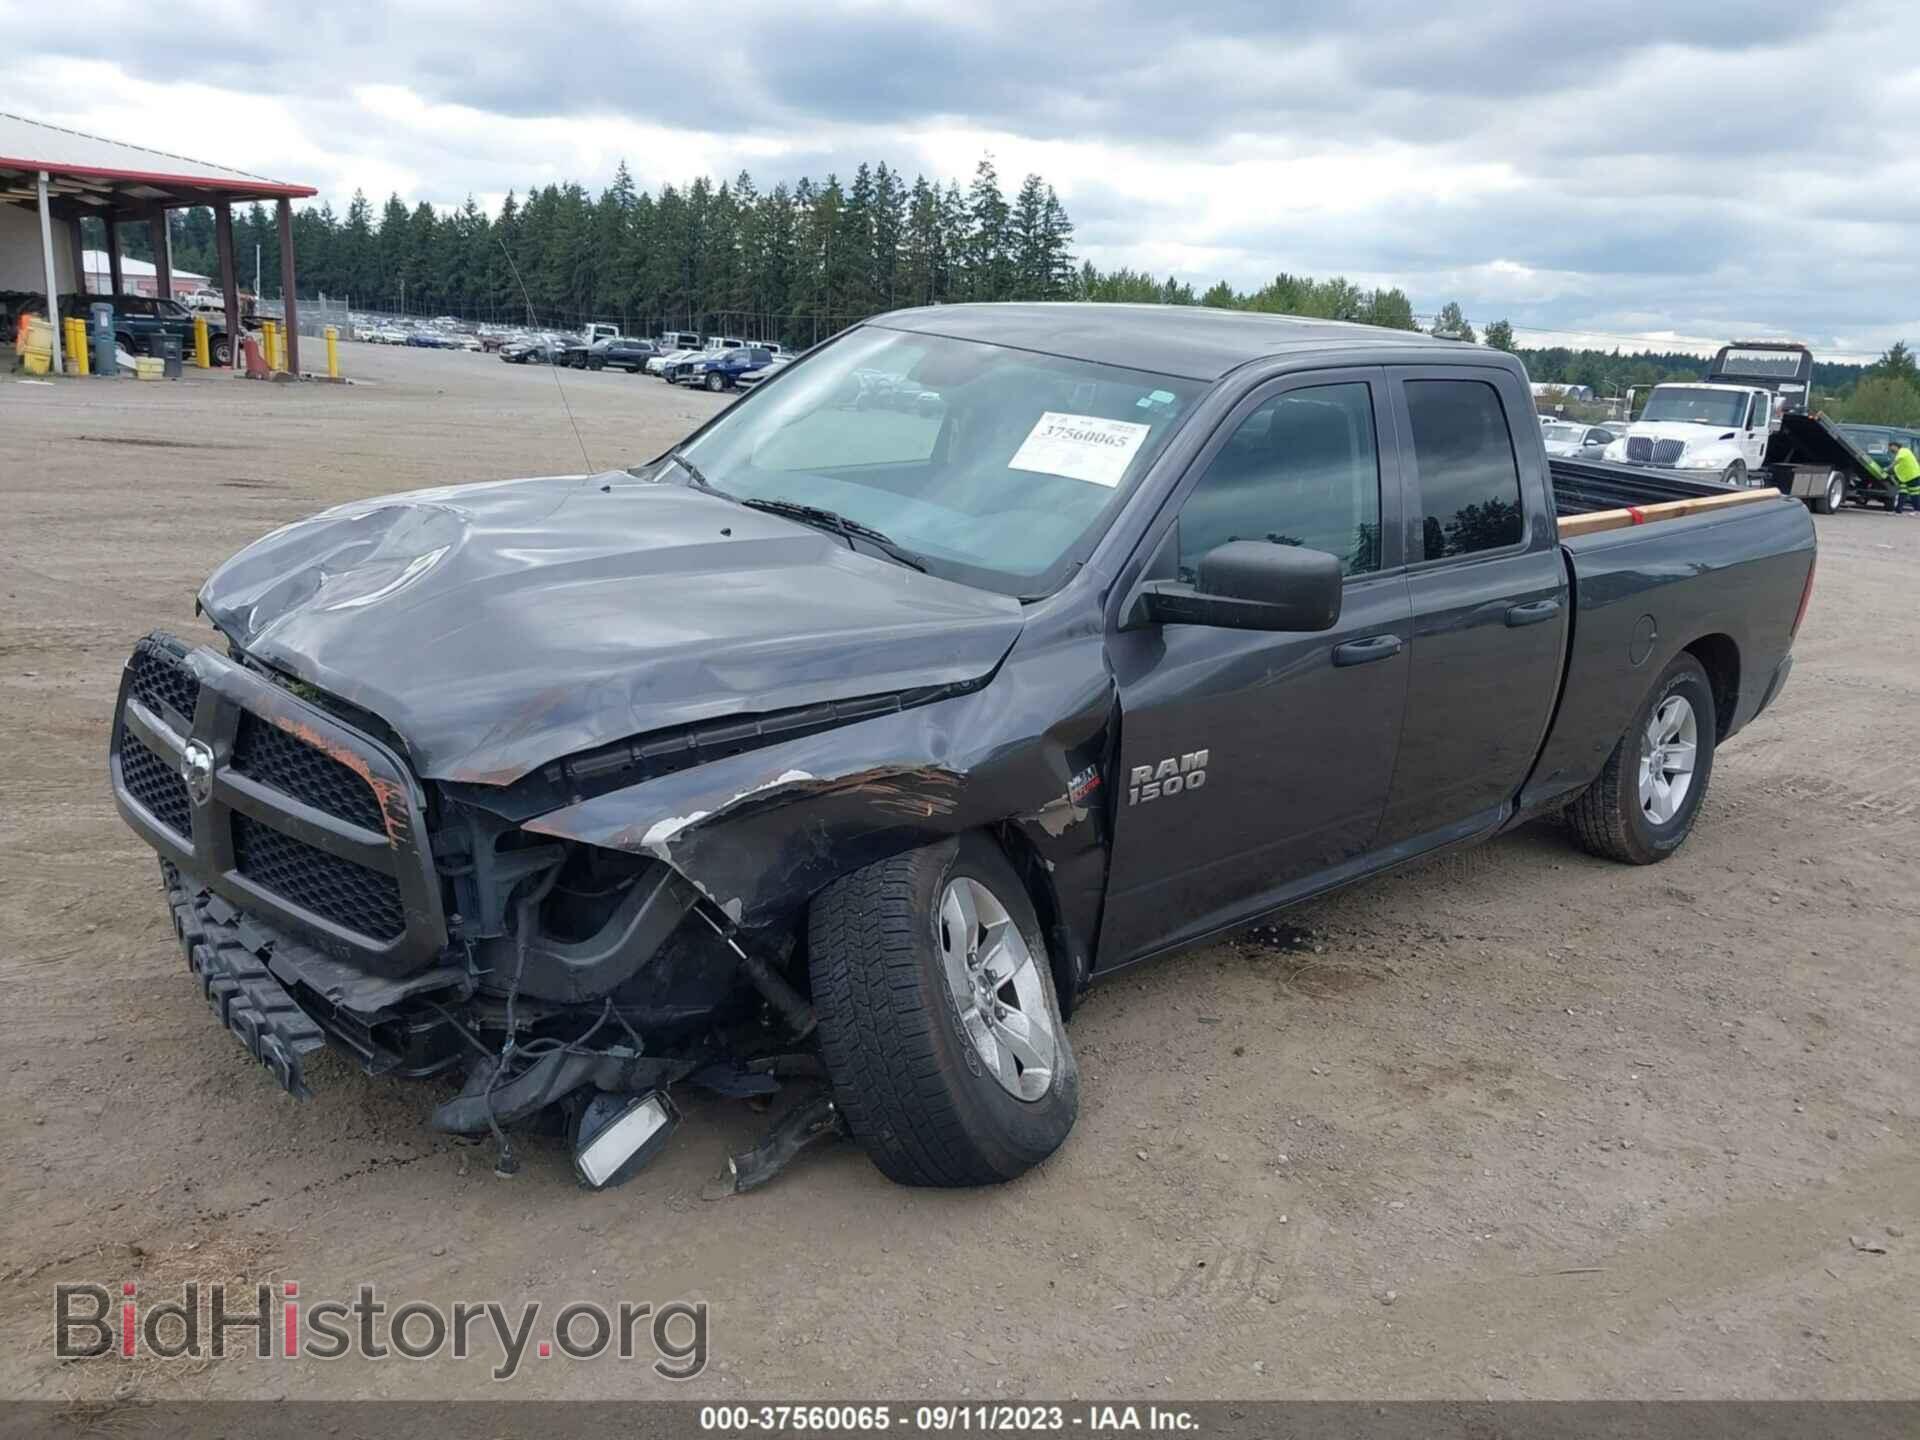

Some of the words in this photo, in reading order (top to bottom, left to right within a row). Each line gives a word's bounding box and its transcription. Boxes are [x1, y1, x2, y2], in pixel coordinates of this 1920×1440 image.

[1041, 425, 1129, 448] 37560065
[1130, 749, 1209, 787] RAM
[1128, 770, 1206, 806] 1500
